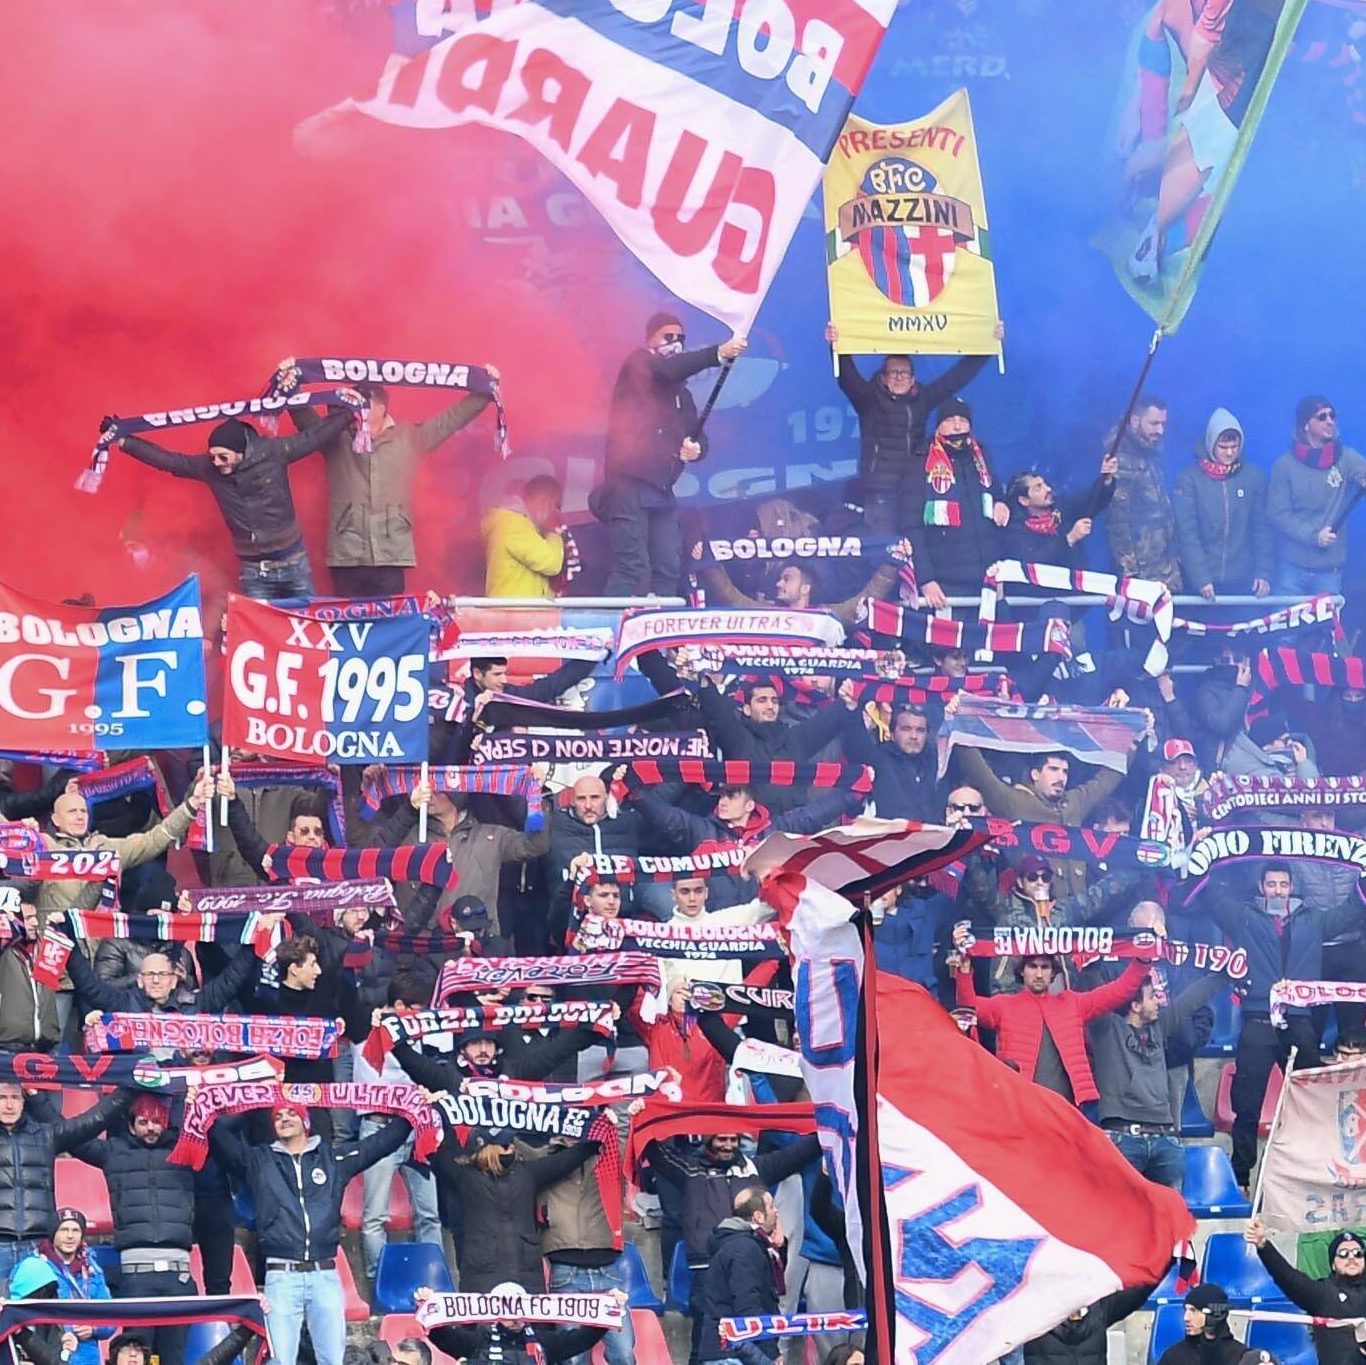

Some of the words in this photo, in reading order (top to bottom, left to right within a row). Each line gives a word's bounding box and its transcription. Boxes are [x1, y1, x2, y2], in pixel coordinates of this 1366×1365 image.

[838, 125, 966, 159] PRESENTI
[869, 162, 926, 196] BFC
[851, 197, 960, 229] MAZZINI
[887, 313, 949, 333] MMXV
[322, 358, 469, 388] BOLOGNA
[711, 536, 862, 561] BOLOGNA
[286, 619, 373, 651] XXV
[644, 616, 719, 633] FOREVER
[724, 617, 793, 632] ULTRAS
[736, 656, 796, 670] VECCHIA
[798, 658, 864, 672] GUARDIA
[784, 665, 814, 676] 1974
[231, 641, 308, 721] G.F.
[320, 656, 425, 723] 1995
[69, 721, 124, 736] 1995
[246, 720, 404, 758] BOLOGNA
[473, 738, 528, 763] SEPARA
[531, 737, 552, 757] CI
[556, 735, 604, 758] NON
[607, 736, 683, 758] MORTE
[1212, 791, 1281, 820] CENTODIECI
[1283, 791, 1321, 804] ANNI
[1323, 791, 1340, 803] DI
[1188, 830, 1251, 877] ODIO
[636, 937, 696, 952] VECCHIA
[698, 940, 764, 955] GUARDIA
[688, 923, 780, 942] BOLOGNA
[1012, 926, 1114, 954] BOLOGNA
[383, 1010, 481, 1042] FORZA
[445, 1093, 560, 1132] BOLOGNA
[564, 1109, 590, 1126] FC
[444, 1294, 525, 1319] BOLOGNA
[529, 1295, 554, 1317] FC
[558, 1295, 600, 1318] 1909
